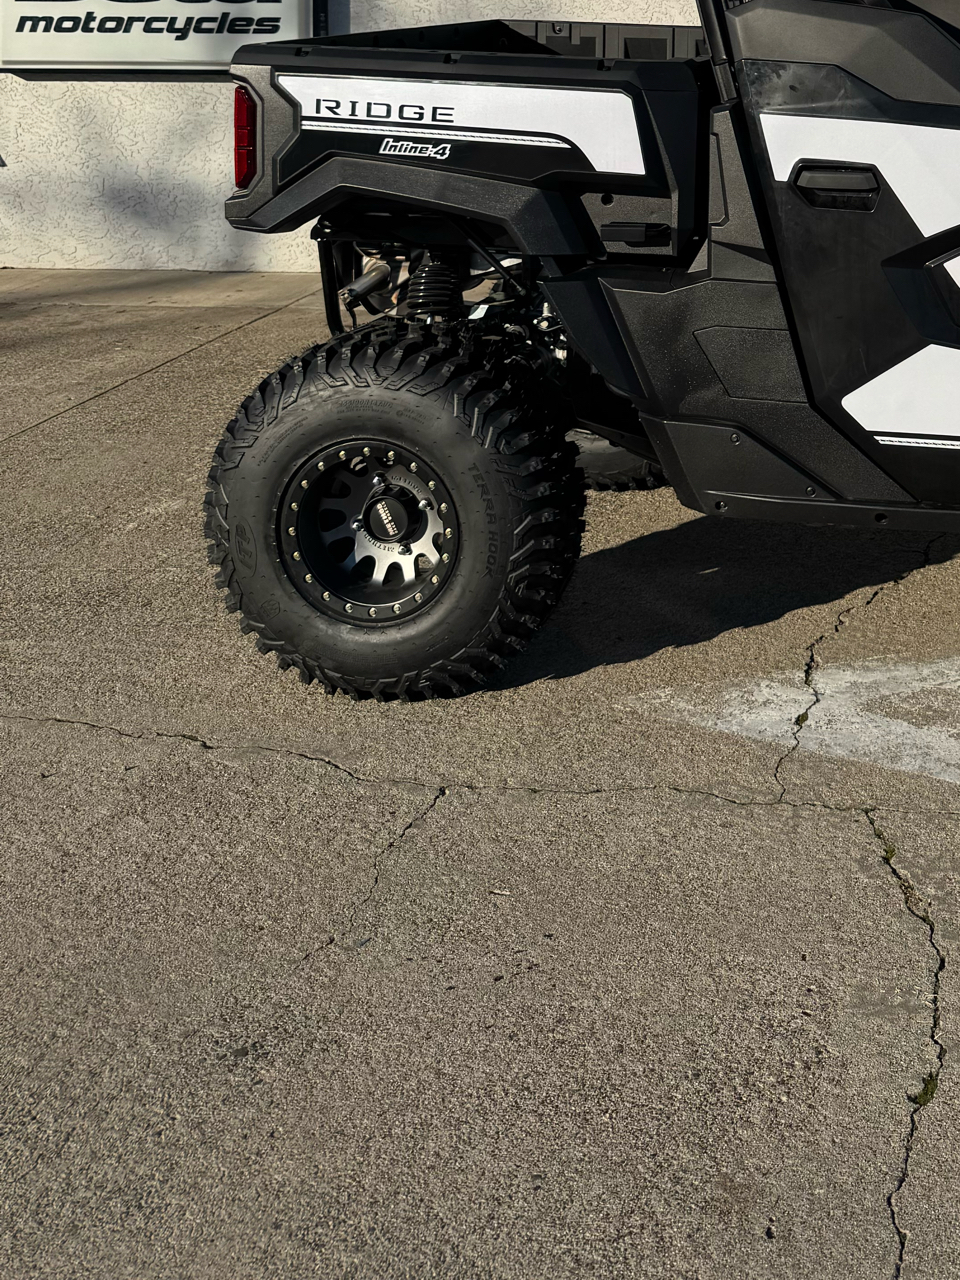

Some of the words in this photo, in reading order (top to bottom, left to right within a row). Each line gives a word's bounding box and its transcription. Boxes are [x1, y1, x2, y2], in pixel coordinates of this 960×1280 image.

[15, 11, 282, 41] motorcycles
[315, 98, 455, 124] RIDGE
[378, 138, 451, 160] Inline-4
[468, 462, 497, 525] TERRA
[481, 530, 499, 579] HOOK
